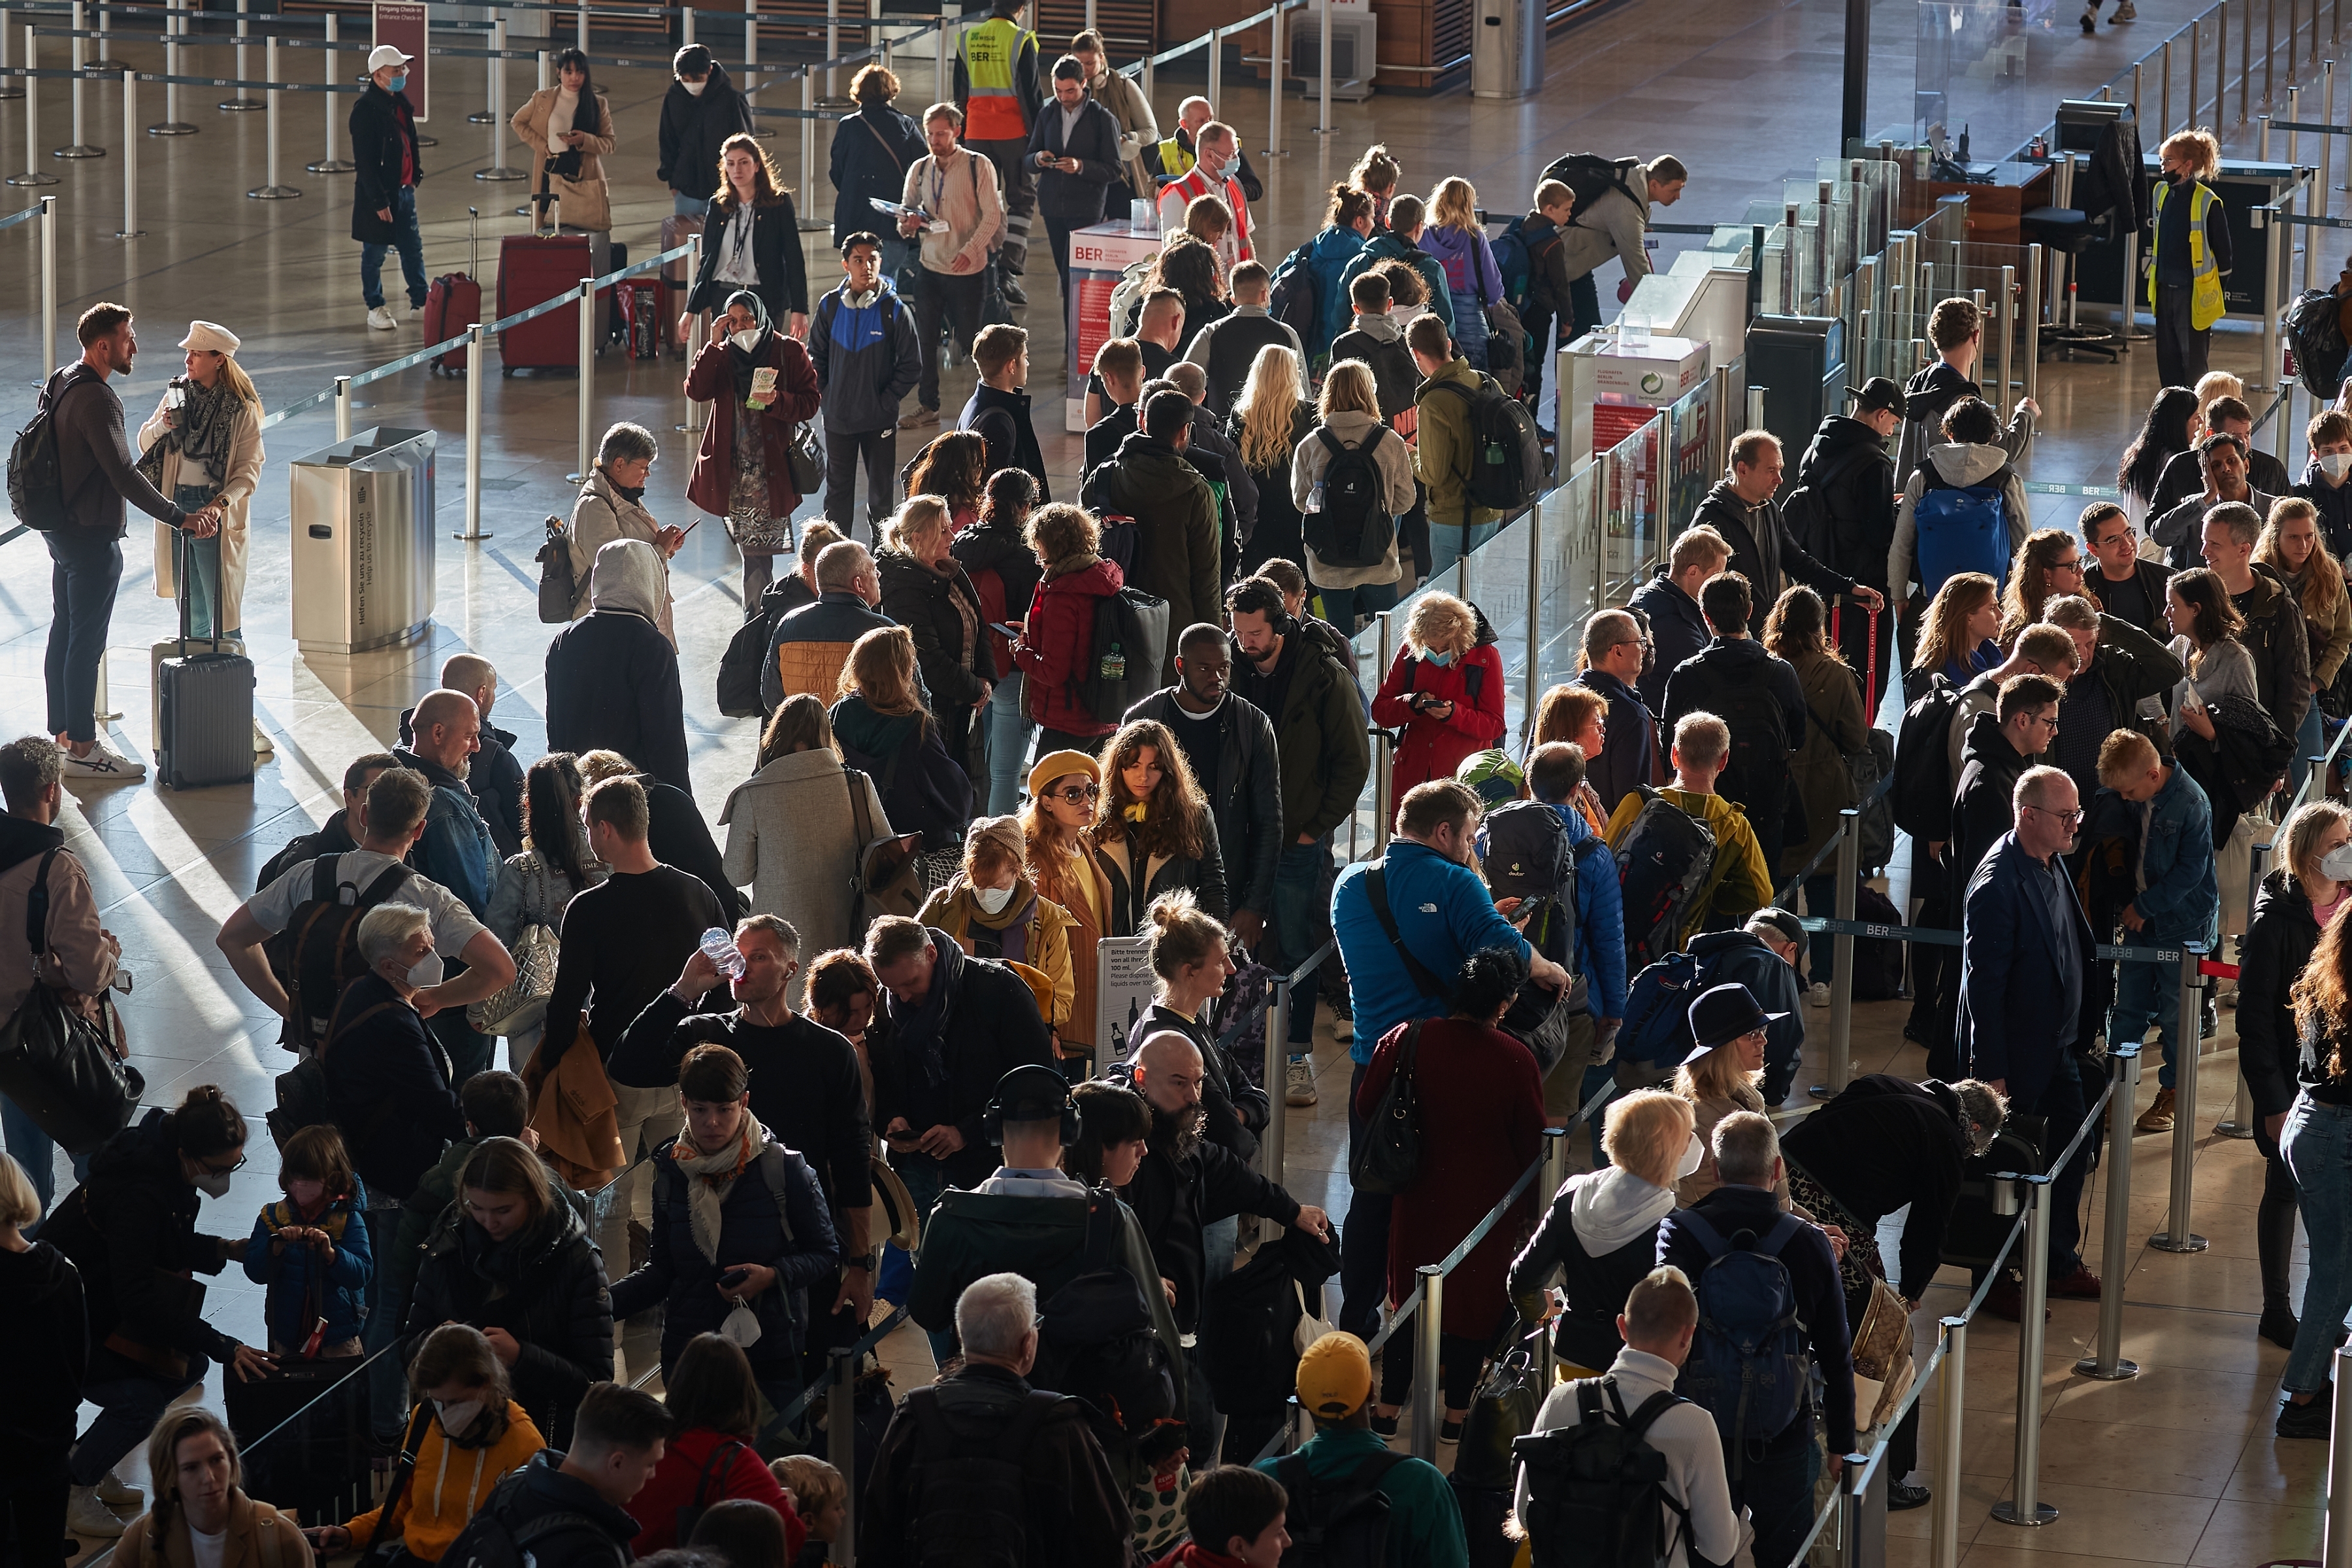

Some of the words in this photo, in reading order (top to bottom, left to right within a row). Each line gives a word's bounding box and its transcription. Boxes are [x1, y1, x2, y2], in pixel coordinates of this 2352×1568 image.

[971, 52, 989, 61] BER
[1075, 246, 1103, 261] BER
[1680, 370, 1690, 388] BER
[2083, 486, 2099, 495] BER
[366, 542, 372, 551] to
[359, 551, 365, 561] zu
[366, 553, 372, 563] us
[1867, 924, 1889, 936] BER
[2157, 951, 2180, 962] BER
[897, 1304, 906, 1322] BER
[804, 1386, 815, 1405] BER
